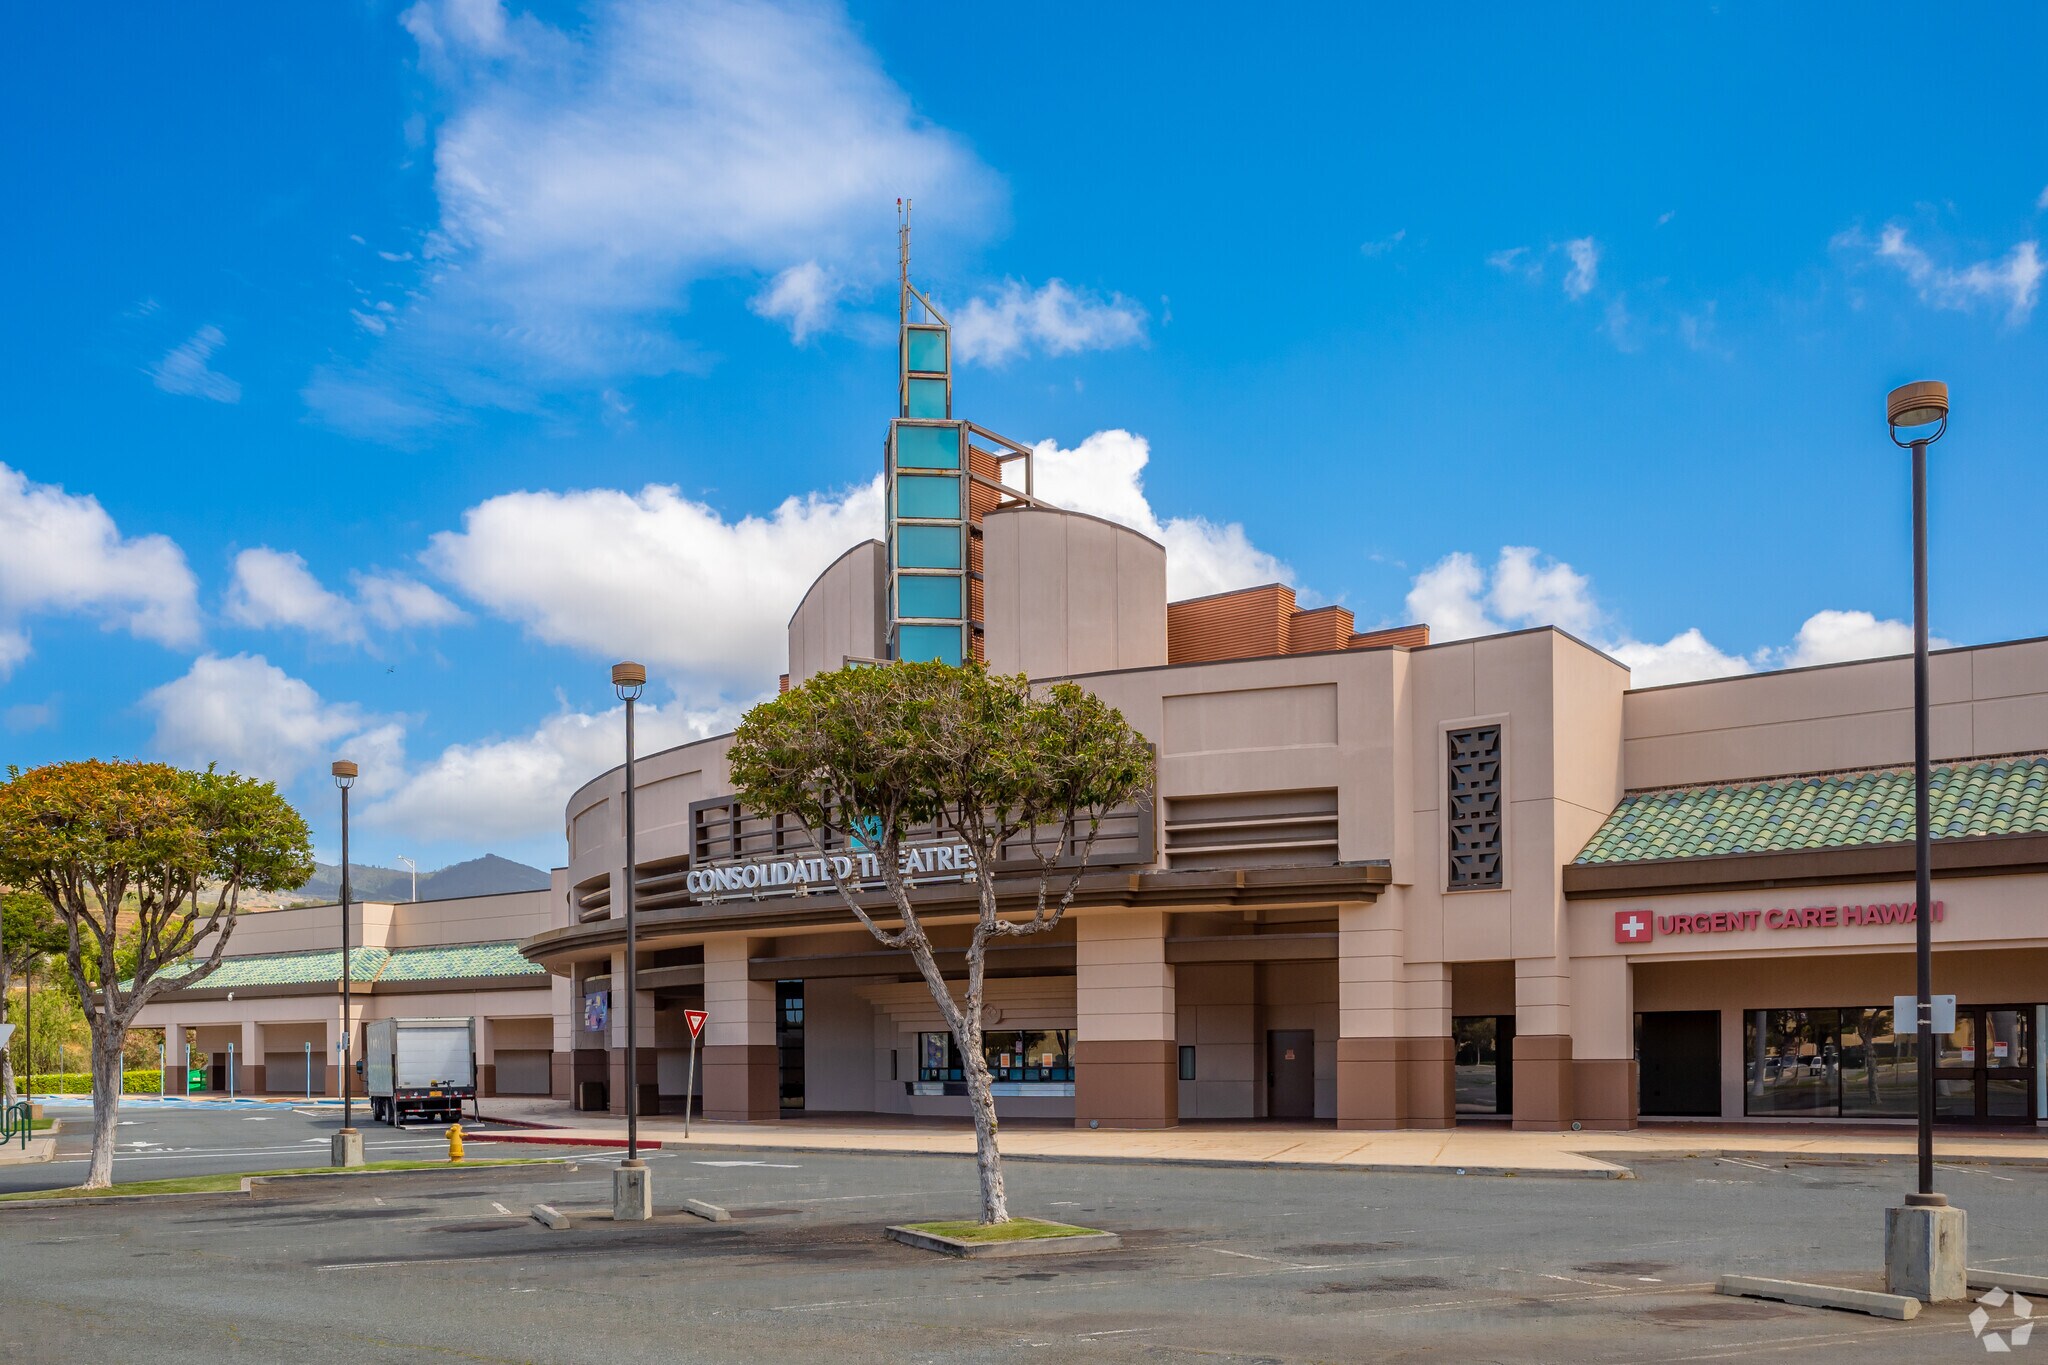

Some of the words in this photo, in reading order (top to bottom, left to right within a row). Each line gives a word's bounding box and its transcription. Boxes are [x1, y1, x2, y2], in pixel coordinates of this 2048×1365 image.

[686, 856, 853, 894] CONSOLIDATED
[1657, 910, 1762, 936] URGENT
[1764, 907, 1839, 930] CARE
